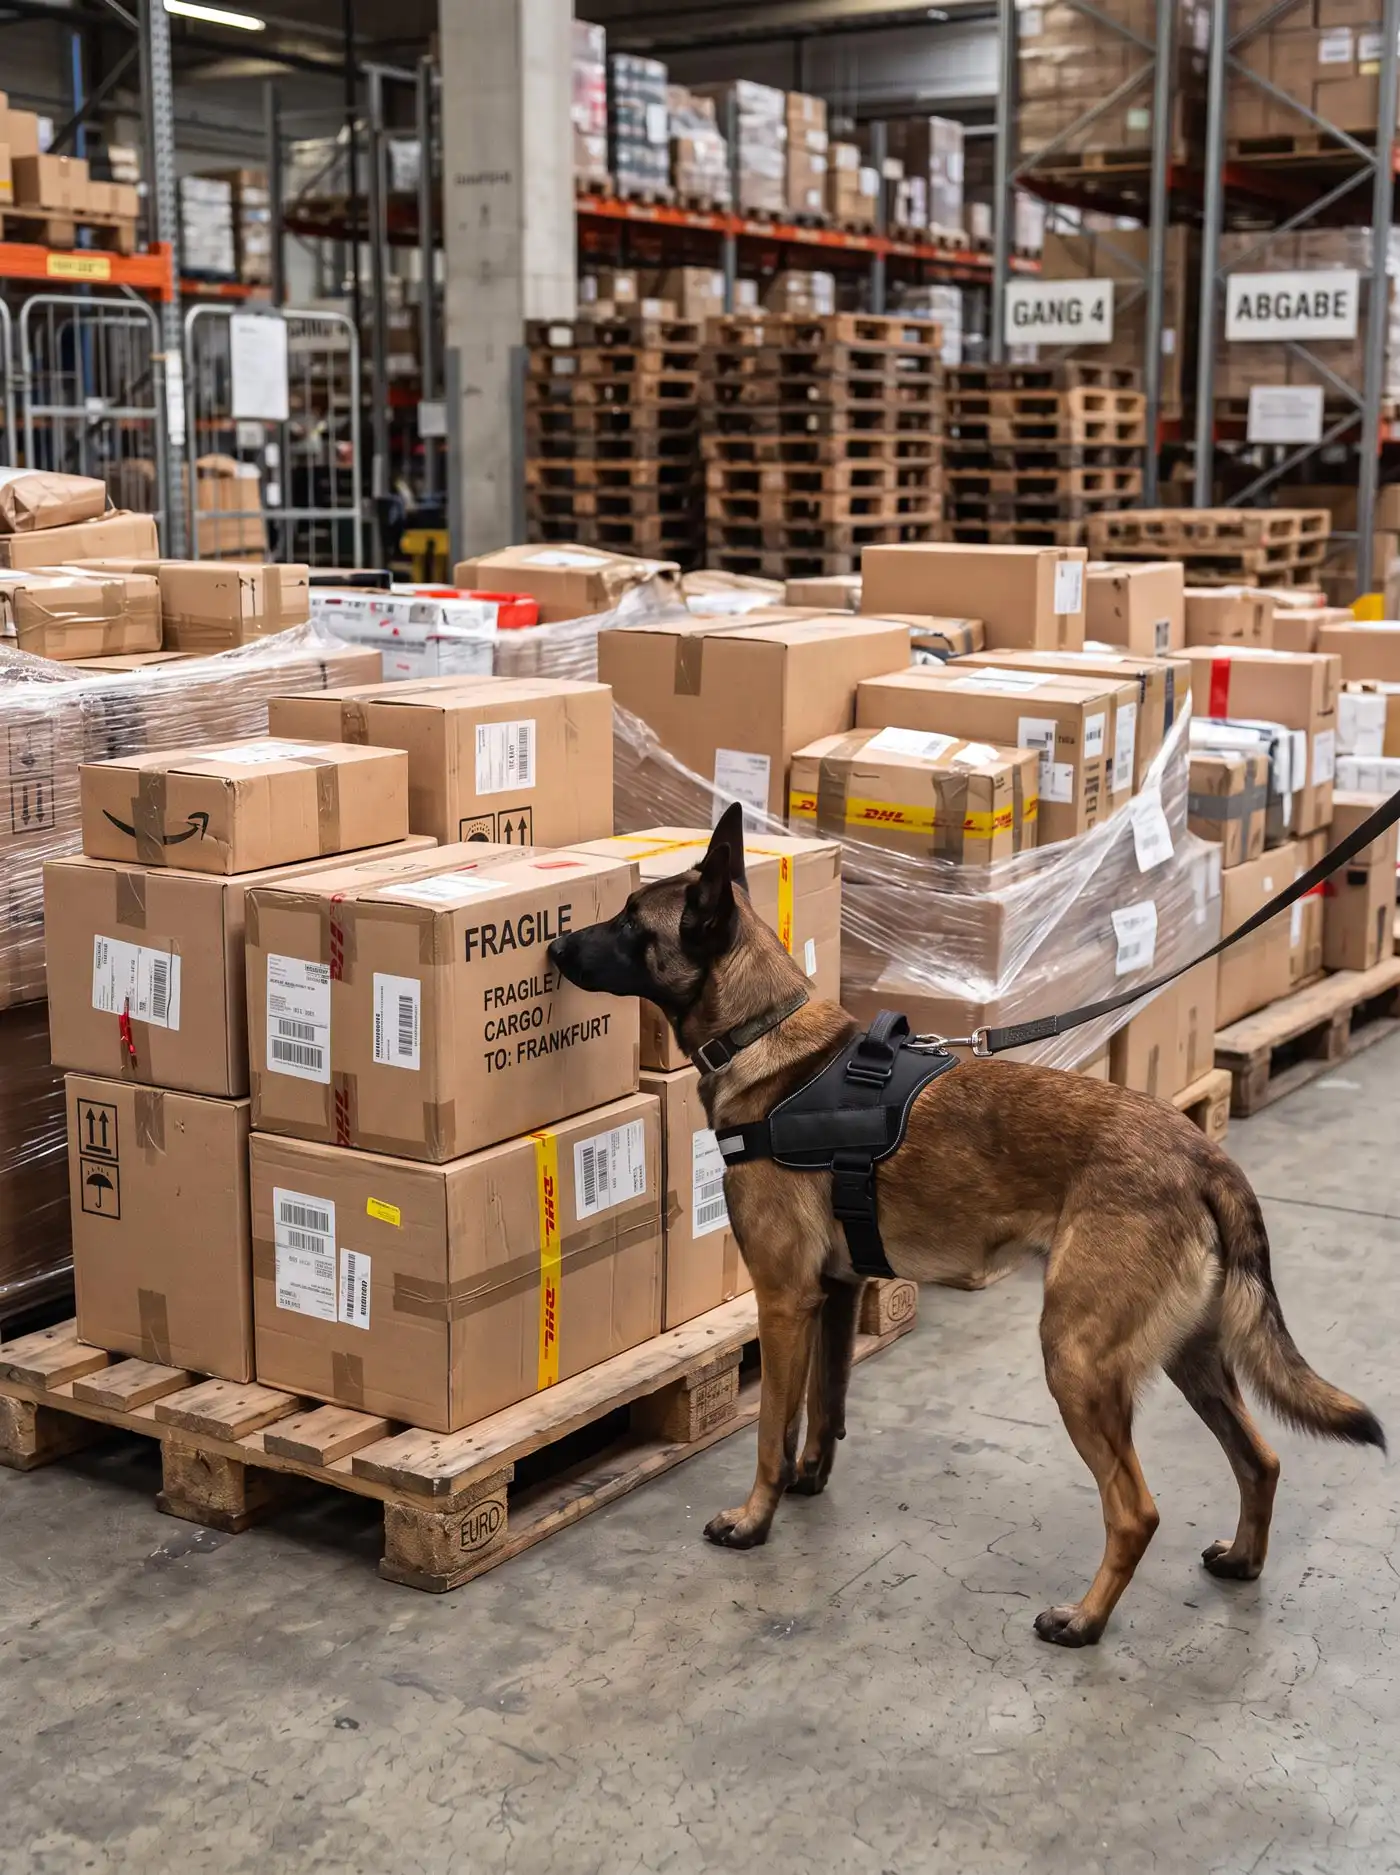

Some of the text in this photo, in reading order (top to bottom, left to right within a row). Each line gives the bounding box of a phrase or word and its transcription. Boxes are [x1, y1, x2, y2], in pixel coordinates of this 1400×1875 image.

[1013, 297, 1104, 326] GANG 4
[1236, 291, 1348, 320] ABGABE
[863, 808, 905, 824] DHL
[465, 904, 572, 962] FRAGILE
[484, 972, 553, 1011] FRAGILE
[484, 1006, 543, 1042] CARGO
[484, 1014, 611, 1073] TO: FRANKFURT
[543, 1175, 555, 1237] DHL
[544, 1287, 555, 1348] DHL
[461, 1506, 500, 1547] EURO
